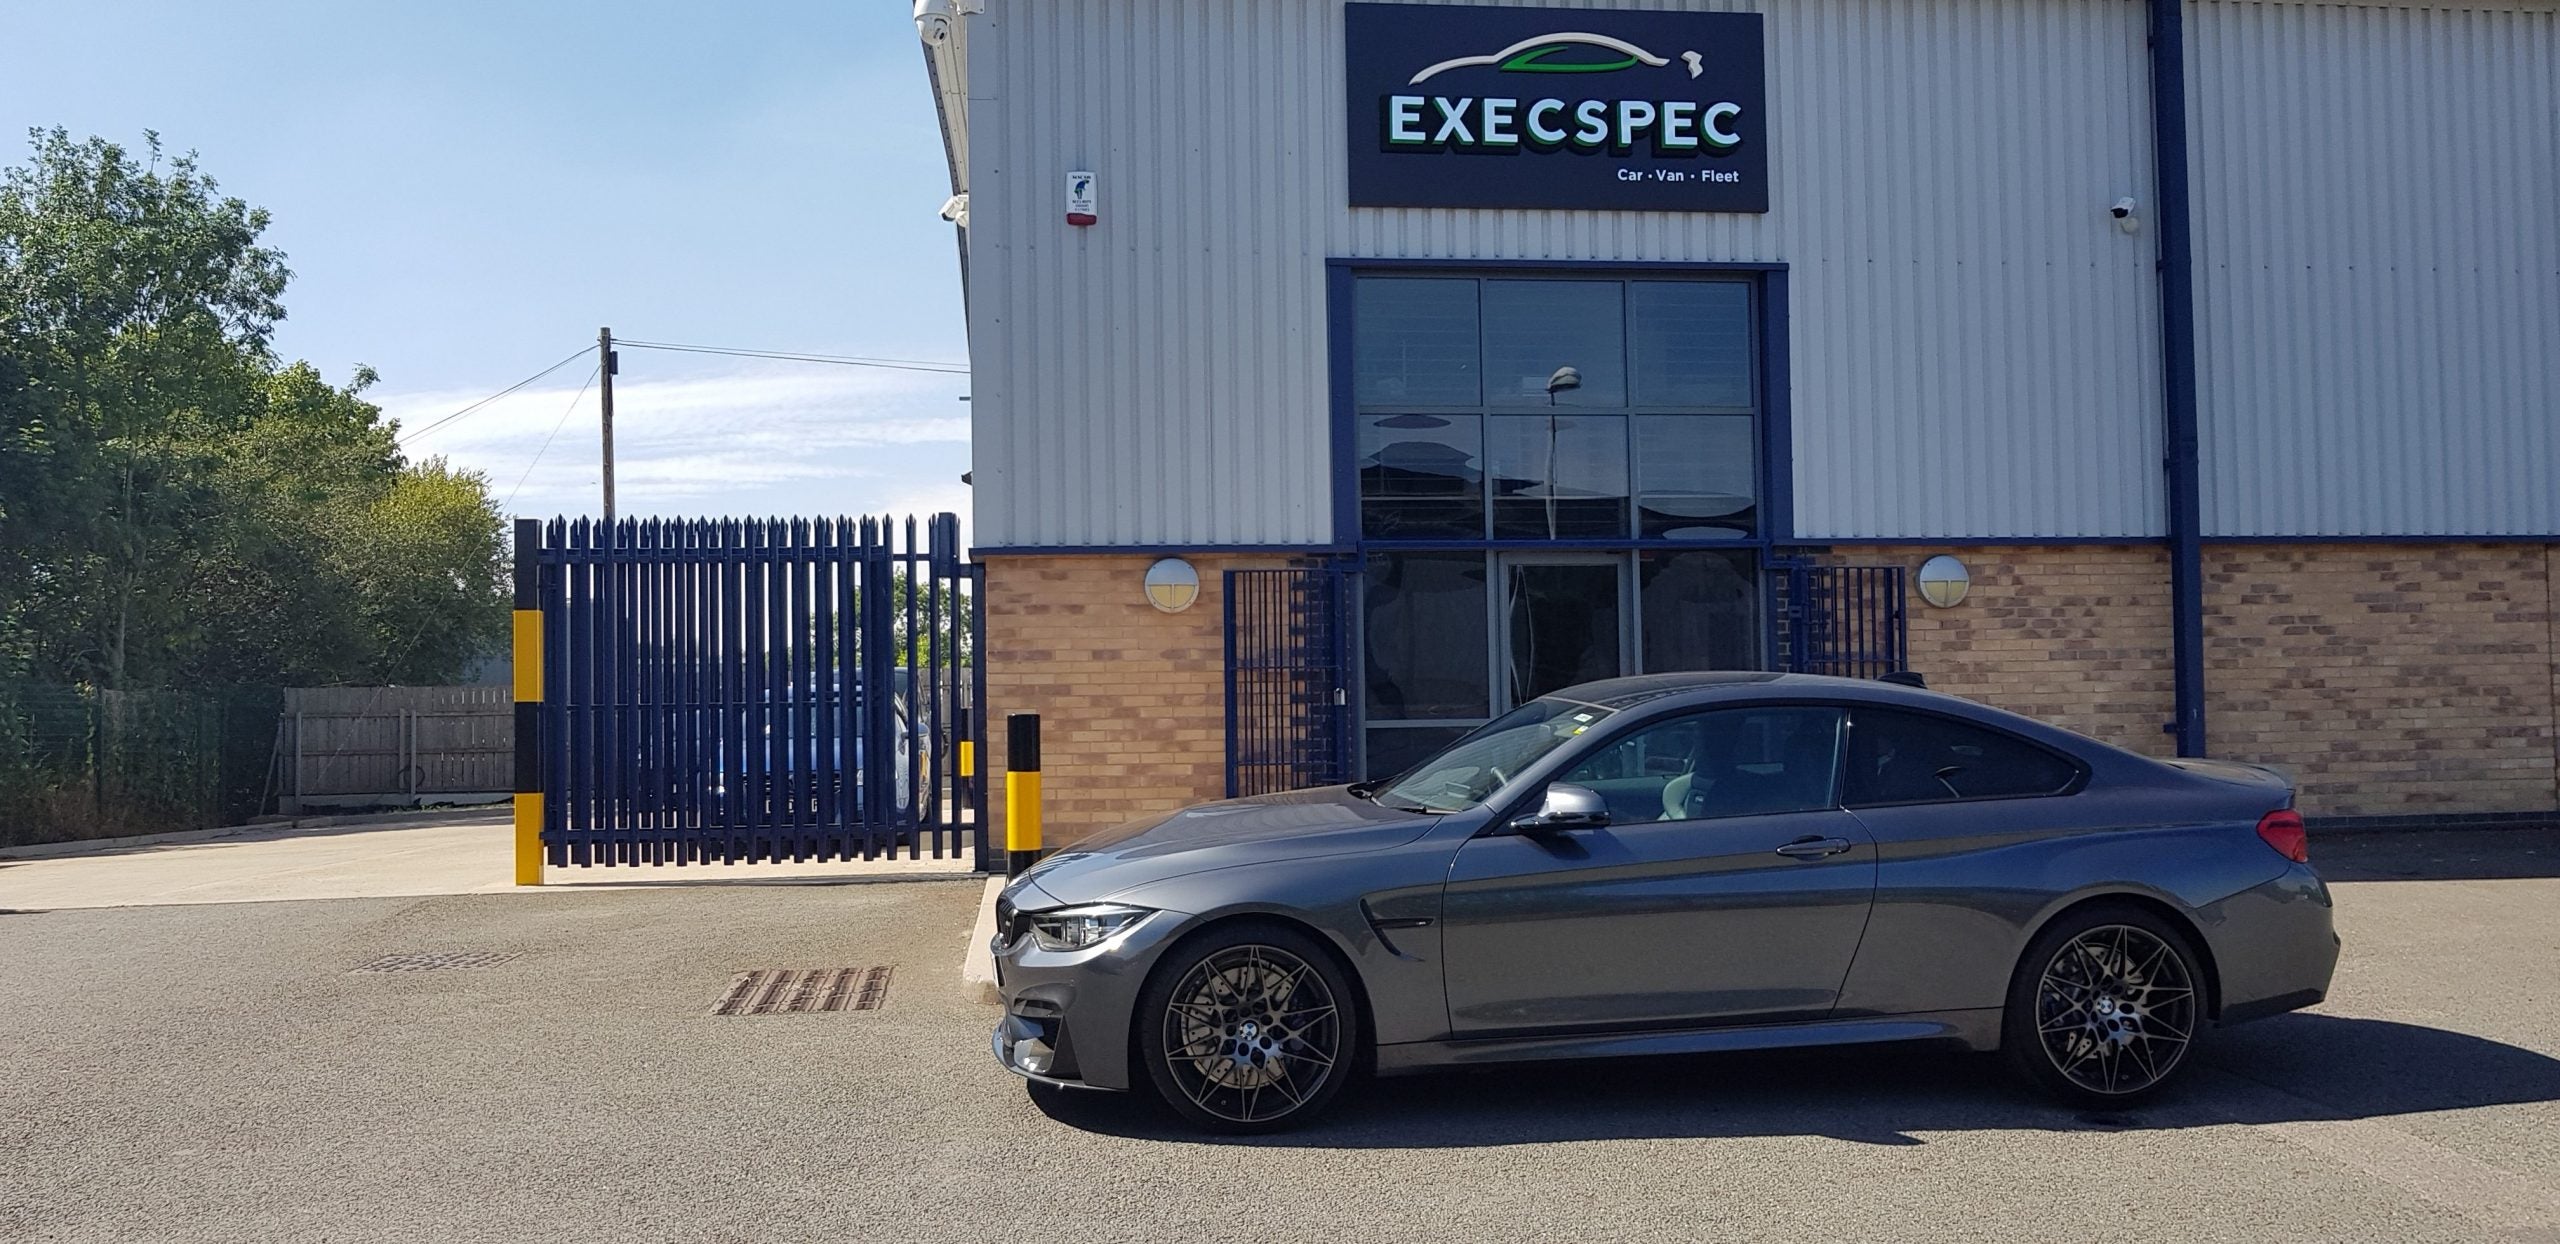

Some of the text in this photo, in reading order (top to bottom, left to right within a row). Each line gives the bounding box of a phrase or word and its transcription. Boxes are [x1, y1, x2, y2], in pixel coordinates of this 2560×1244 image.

[1389, 95, 1741, 147] EXECSPEC
[1617, 168, 1739, 183] Car Van Fleet
